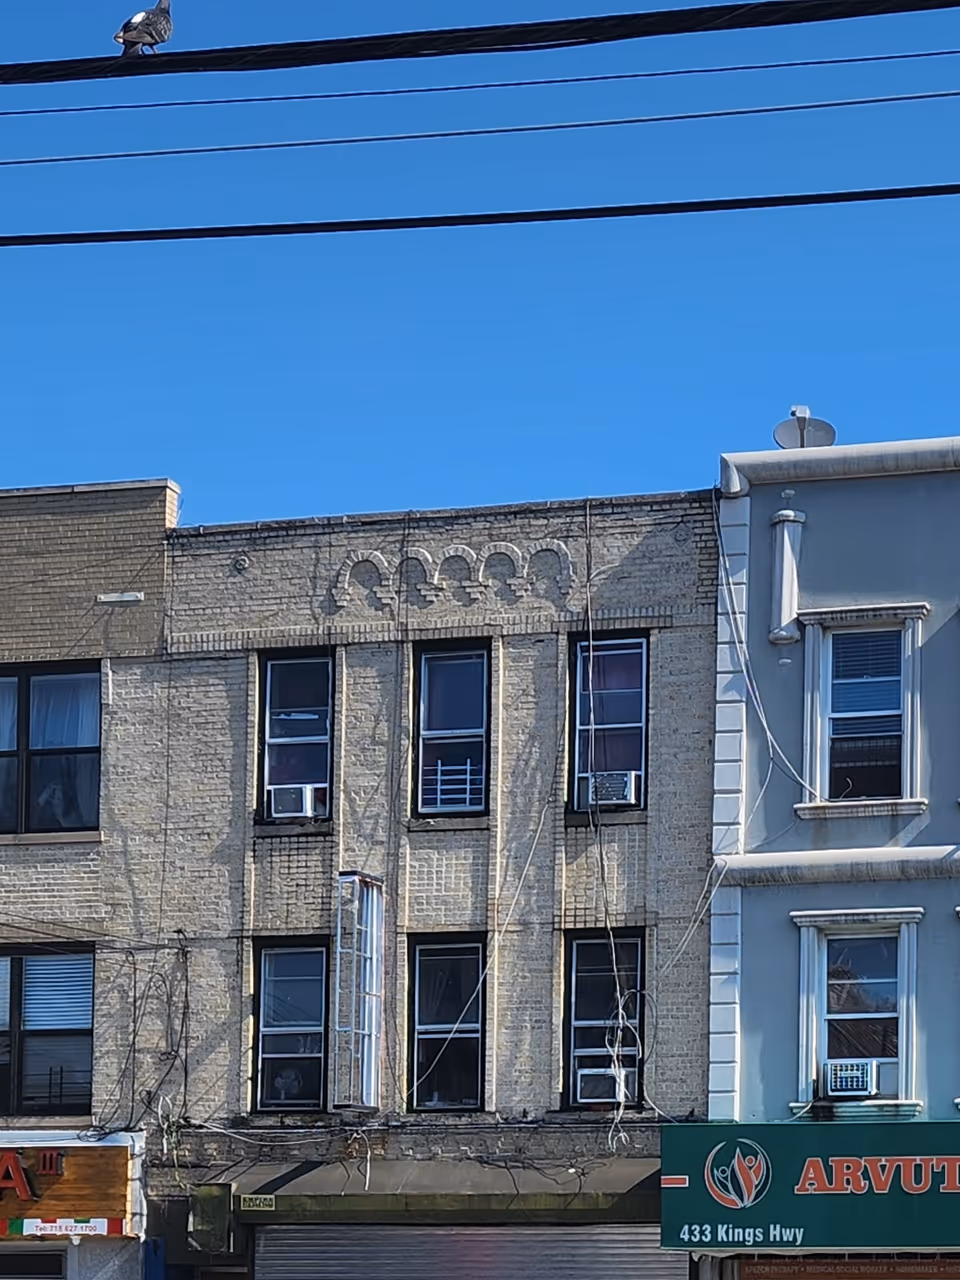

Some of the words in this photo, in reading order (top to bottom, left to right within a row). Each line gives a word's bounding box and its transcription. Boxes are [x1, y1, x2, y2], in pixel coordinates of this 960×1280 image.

[679, 1224, 712, 1243] 433
[717, 1223, 763, 1244] Kings
[769, 1223, 804, 1245] Hwy
